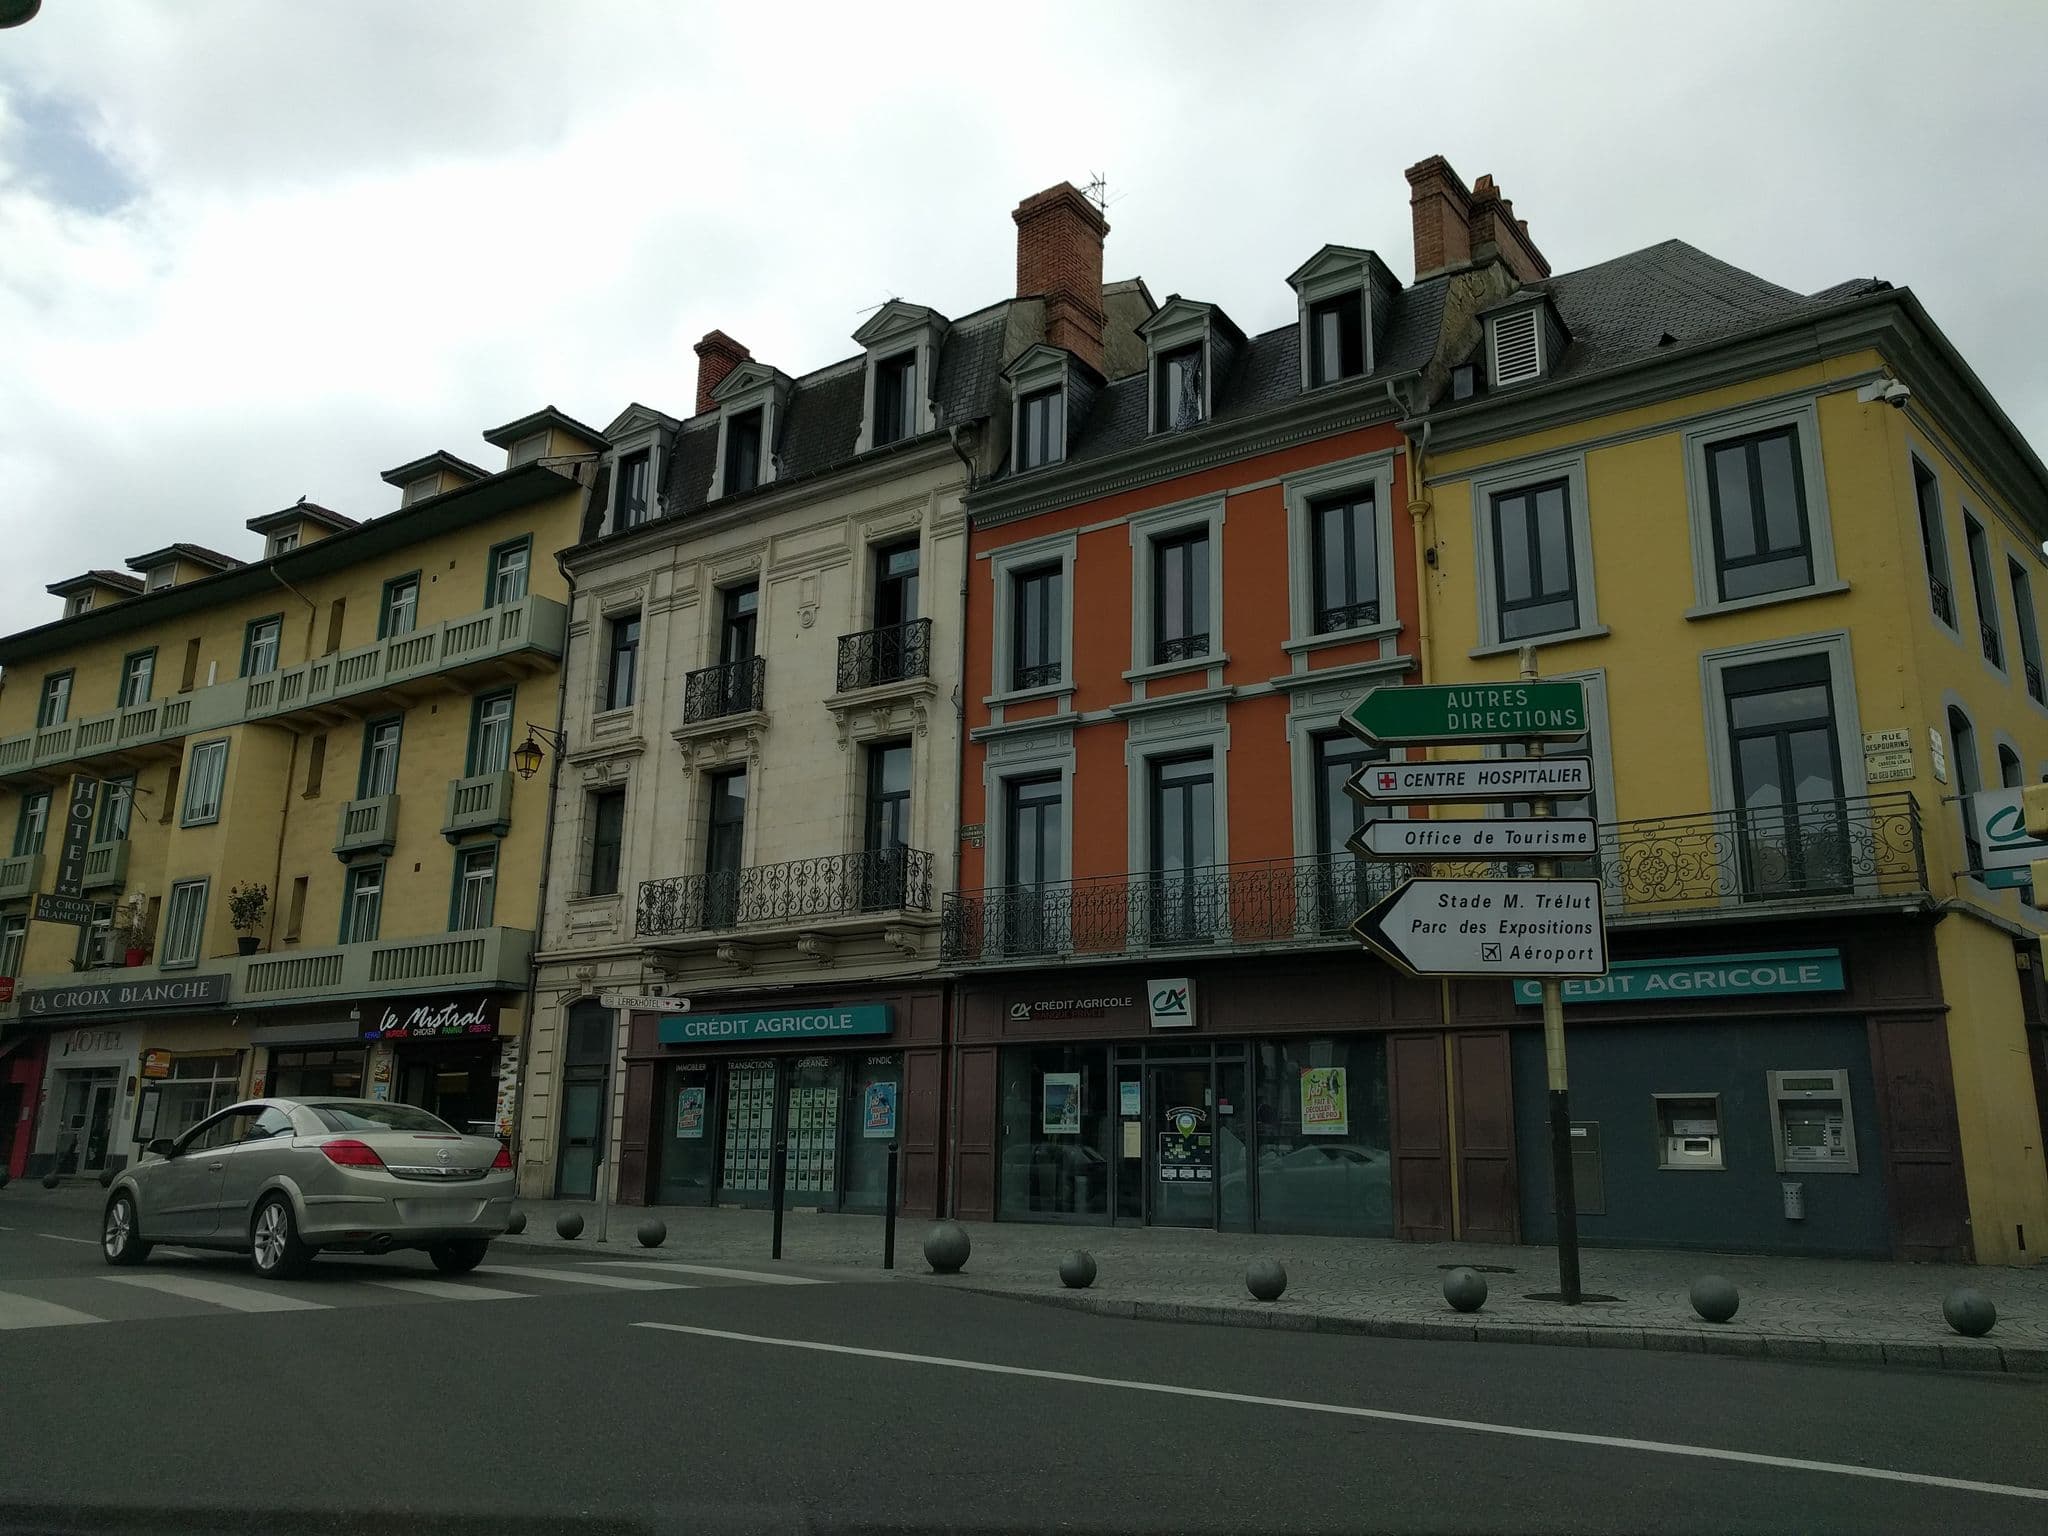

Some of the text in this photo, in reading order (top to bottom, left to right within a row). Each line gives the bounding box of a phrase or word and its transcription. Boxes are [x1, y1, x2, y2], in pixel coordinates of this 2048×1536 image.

[1447, 689, 1528, 708] AUTRES
[1448, 709, 1577, 730] DIRECTIONS
[1882, 733, 1902, 741] RUE
[1404, 768, 1582, 788] CENTRE HOSPITALIER
[66, 782, 97, 882] HOTEL
[1405, 830, 1587, 845] Office de Tourisme
[55, 900, 92, 913] CROIX
[1438, 892, 1591, 908] Stade M. Trélut
[38, 909, 90, 923] BLANCHE
[1412, 919, 1593, 938] Parc des Expositions
[1509, 945, 1594, 964] Aéroport
[1644, 965, 1821, 993] AGRICOLE
[29, 981, 210, 1013] LA CROIX BLANCHE
[1076, 996, 1133, 1009] AGRICOLE
[413, 1028, 436, 1037] CHICKEN
[685, 1014, 854, 1037] CRÉDIT AGRICOLE
[727, 1058, 774, 1071] TRANSACTIONS
[867, 1055, 892, 1067] SYNDIC
